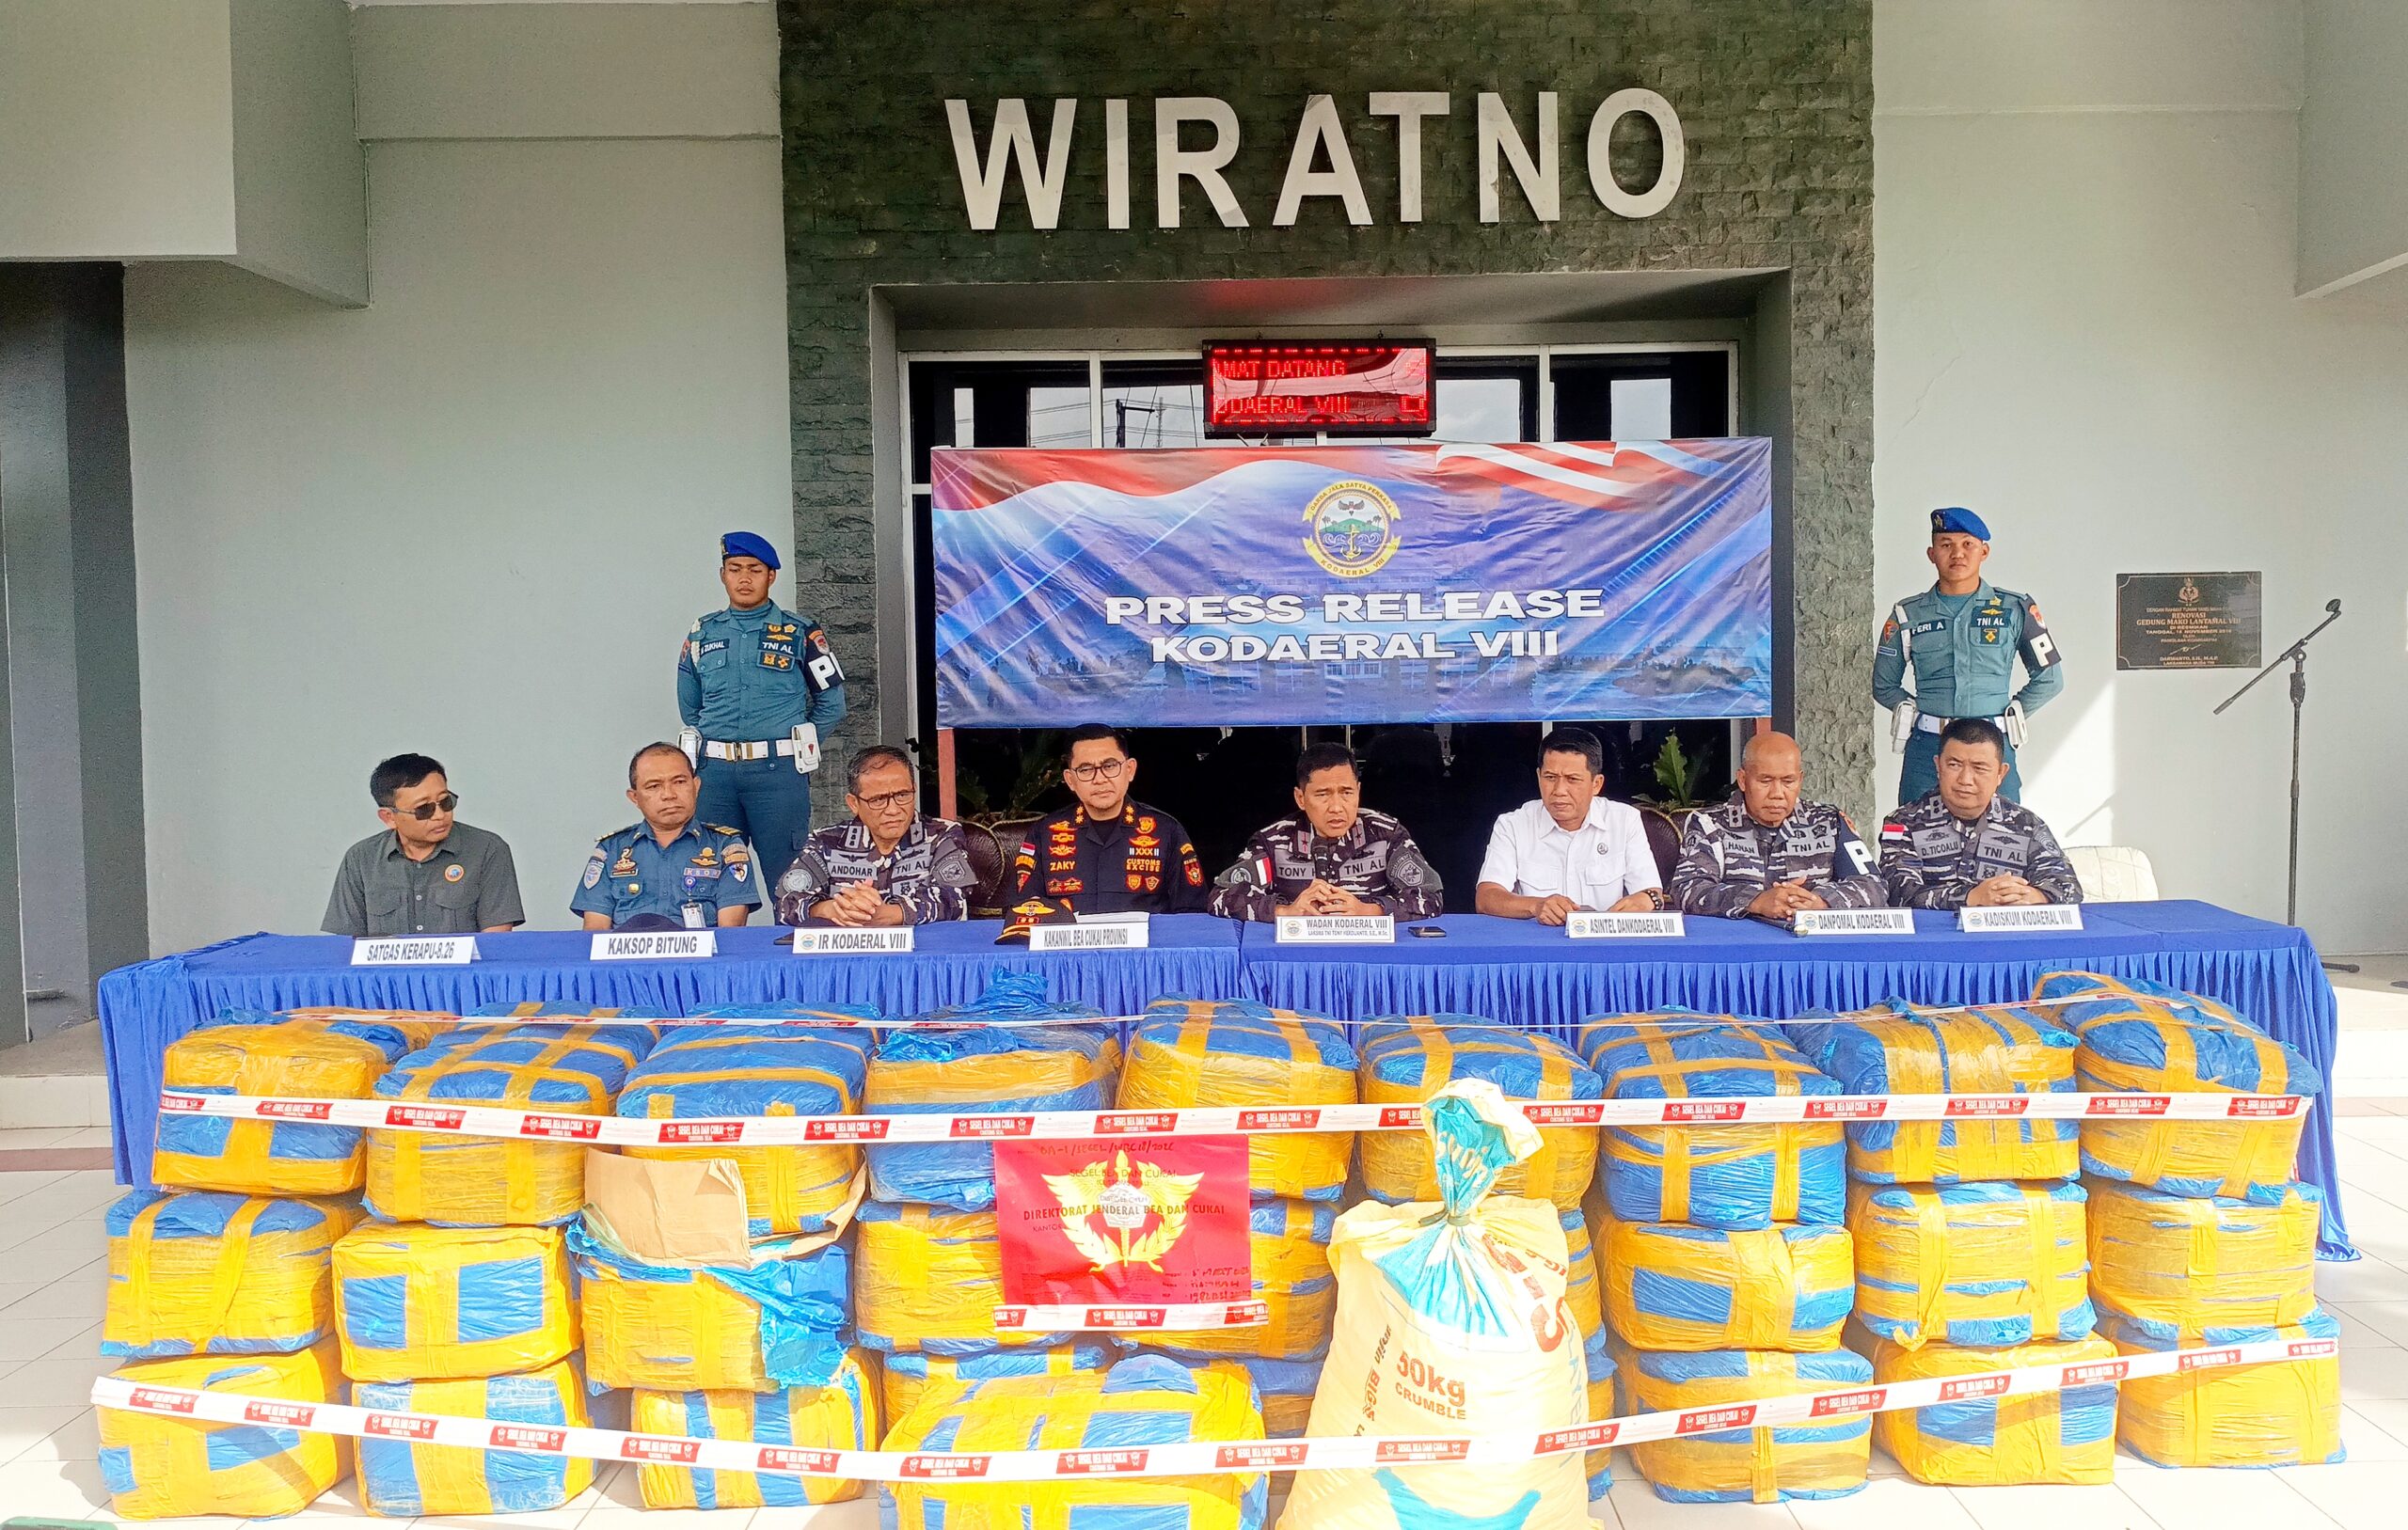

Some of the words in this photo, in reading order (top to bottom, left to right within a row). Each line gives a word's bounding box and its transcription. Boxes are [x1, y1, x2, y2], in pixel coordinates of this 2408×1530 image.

[945, 88, 1685, 229] WIRATNO
[1268, 360, 1346, 377] DATANG
[1316, 396, 1350, 414] VIII
[1320, 560, 1370, 576] KODAERAL
[1373, 558, 1385, 569] VIII
[1104, 594, 1307, 625] PRESS
[1323, 589, 1606, 623] RELEASE
[1937, 622, 1944, 630] A
[1976, 618, 1991, 626] TNI
[1993, 618, 2005, 626] AL
[762, 641, 779, 651] TNI
[781, 644, 794, 655] AL
[1151, 631, 1455, 663] KODAERAL
[1469, 630, 1559, 658] VIII
[1794, 844, 1812, 852] TNI
[1815, 841, 1830, 849] AL
[1930, 842, 1959, 855] TICOALU
[1985, 847, 2002, 859] TNI
[2007, 852, 2022, 862] AL
[831, 865, 873, 876] ANDOHAR
[895, 862, 911, 874] TNI
[914, 860, 929, 870] AL
[1050, 860, 1075, 871] ZAKY
[1279, 866, 1306, 877] TONY
[1344, 864, 1364, 875] TNI
[1370, 860, 1385, 871] AL
[1307, 919, 1333, 928] WADAN
[1336, 919, 1373, 928] KODAERAL
[1375, 920, 1387, 928] VIII
[1590, 919, 1616, 934] ASINTEL
[1618, 919, 1663, 934] DANKODAERAL
[1664, 918, 1675, 933] VIII
[1819, 914, 1856, 929] DANPOMAL
[1857, 914, 1893, 929] KODAERAL
[1893, 914, 1906, 928] VIII
[1984, 912, 2021, 926] KADISKUM
[2022, 911, 2059, 925] KODAERAL
[2060, 910, 2073, 924] VIII
[608, 938, 653, 955] KAKSOP
[656, 936, 697, 954] BITUNG
[818, 934, 828, 950] IR
[832, 933, 886, 950] KODAERAL
[889, 933, 906, 949] VIII
[1044, 930, 1071, 947] KAKANWIL
[1073, 929, 1084, 946] BEA
[1085, 929, 1101, 946] CUKAI
[1103, 928, 1128, 945] PROVINSI
[367, 944, 400, 961] SATGAS
[401, 942, 455, 960] KERAPU-8.26
[1069, 1169, 1100, 1177] SEGEL
[1121, 1169, 1141, 1177] DAN
[1146, 1169, 1176, 1177] CUKAI
[1023, 1205, 1088, 1221] DIREKTORAT
[1092, 1205, 1140, 1215] JENDERAL
[1144, 1205, 1163, 1214] BEA
[1167, 1205, 1188, 1215] DAN
[1193, 1205, 1225, 1215] CUKAI
[1397, 1350, 1465, 1407] 50kg
[1395, 1382, 1466, 1420] CRUMBLE
